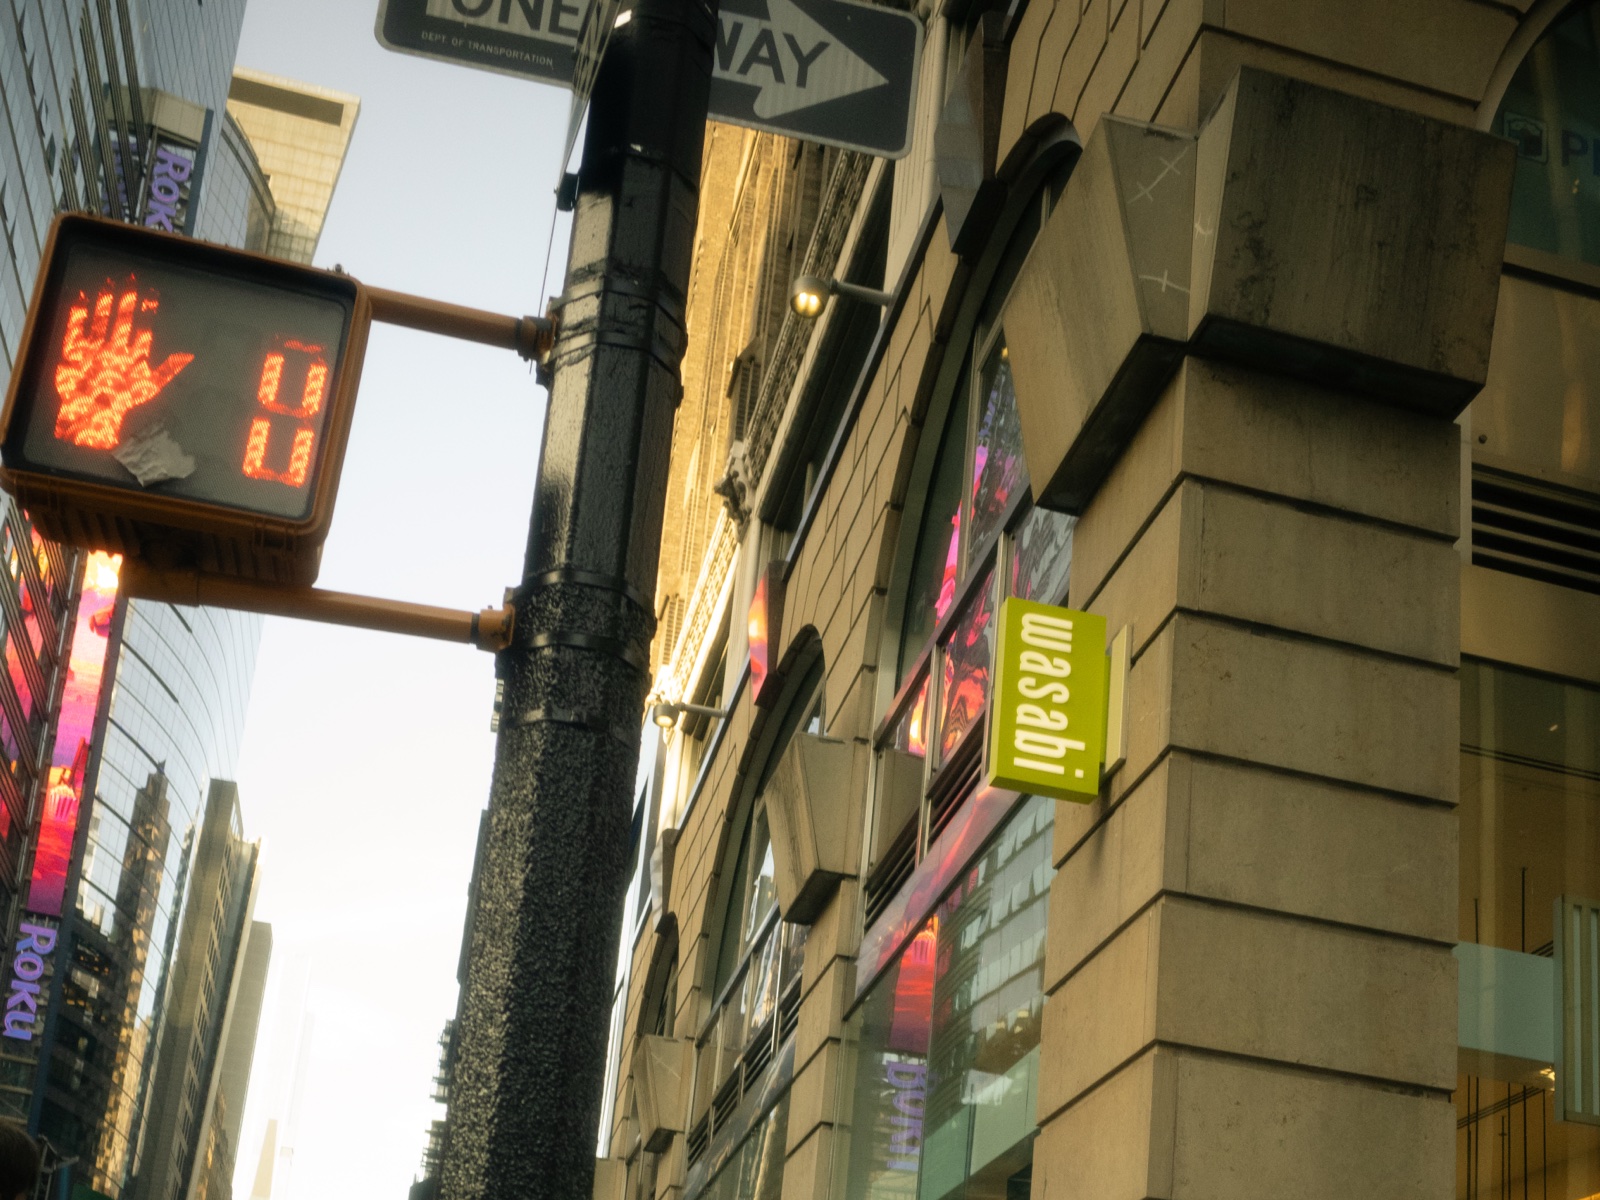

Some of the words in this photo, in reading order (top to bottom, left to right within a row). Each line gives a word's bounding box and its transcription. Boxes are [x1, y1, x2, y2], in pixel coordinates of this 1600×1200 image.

[451, 37, 464, 48] OF
[468, 40, 554, 67] TRANSPORTATION
[1013, 612, 1086, 779] wasabi
